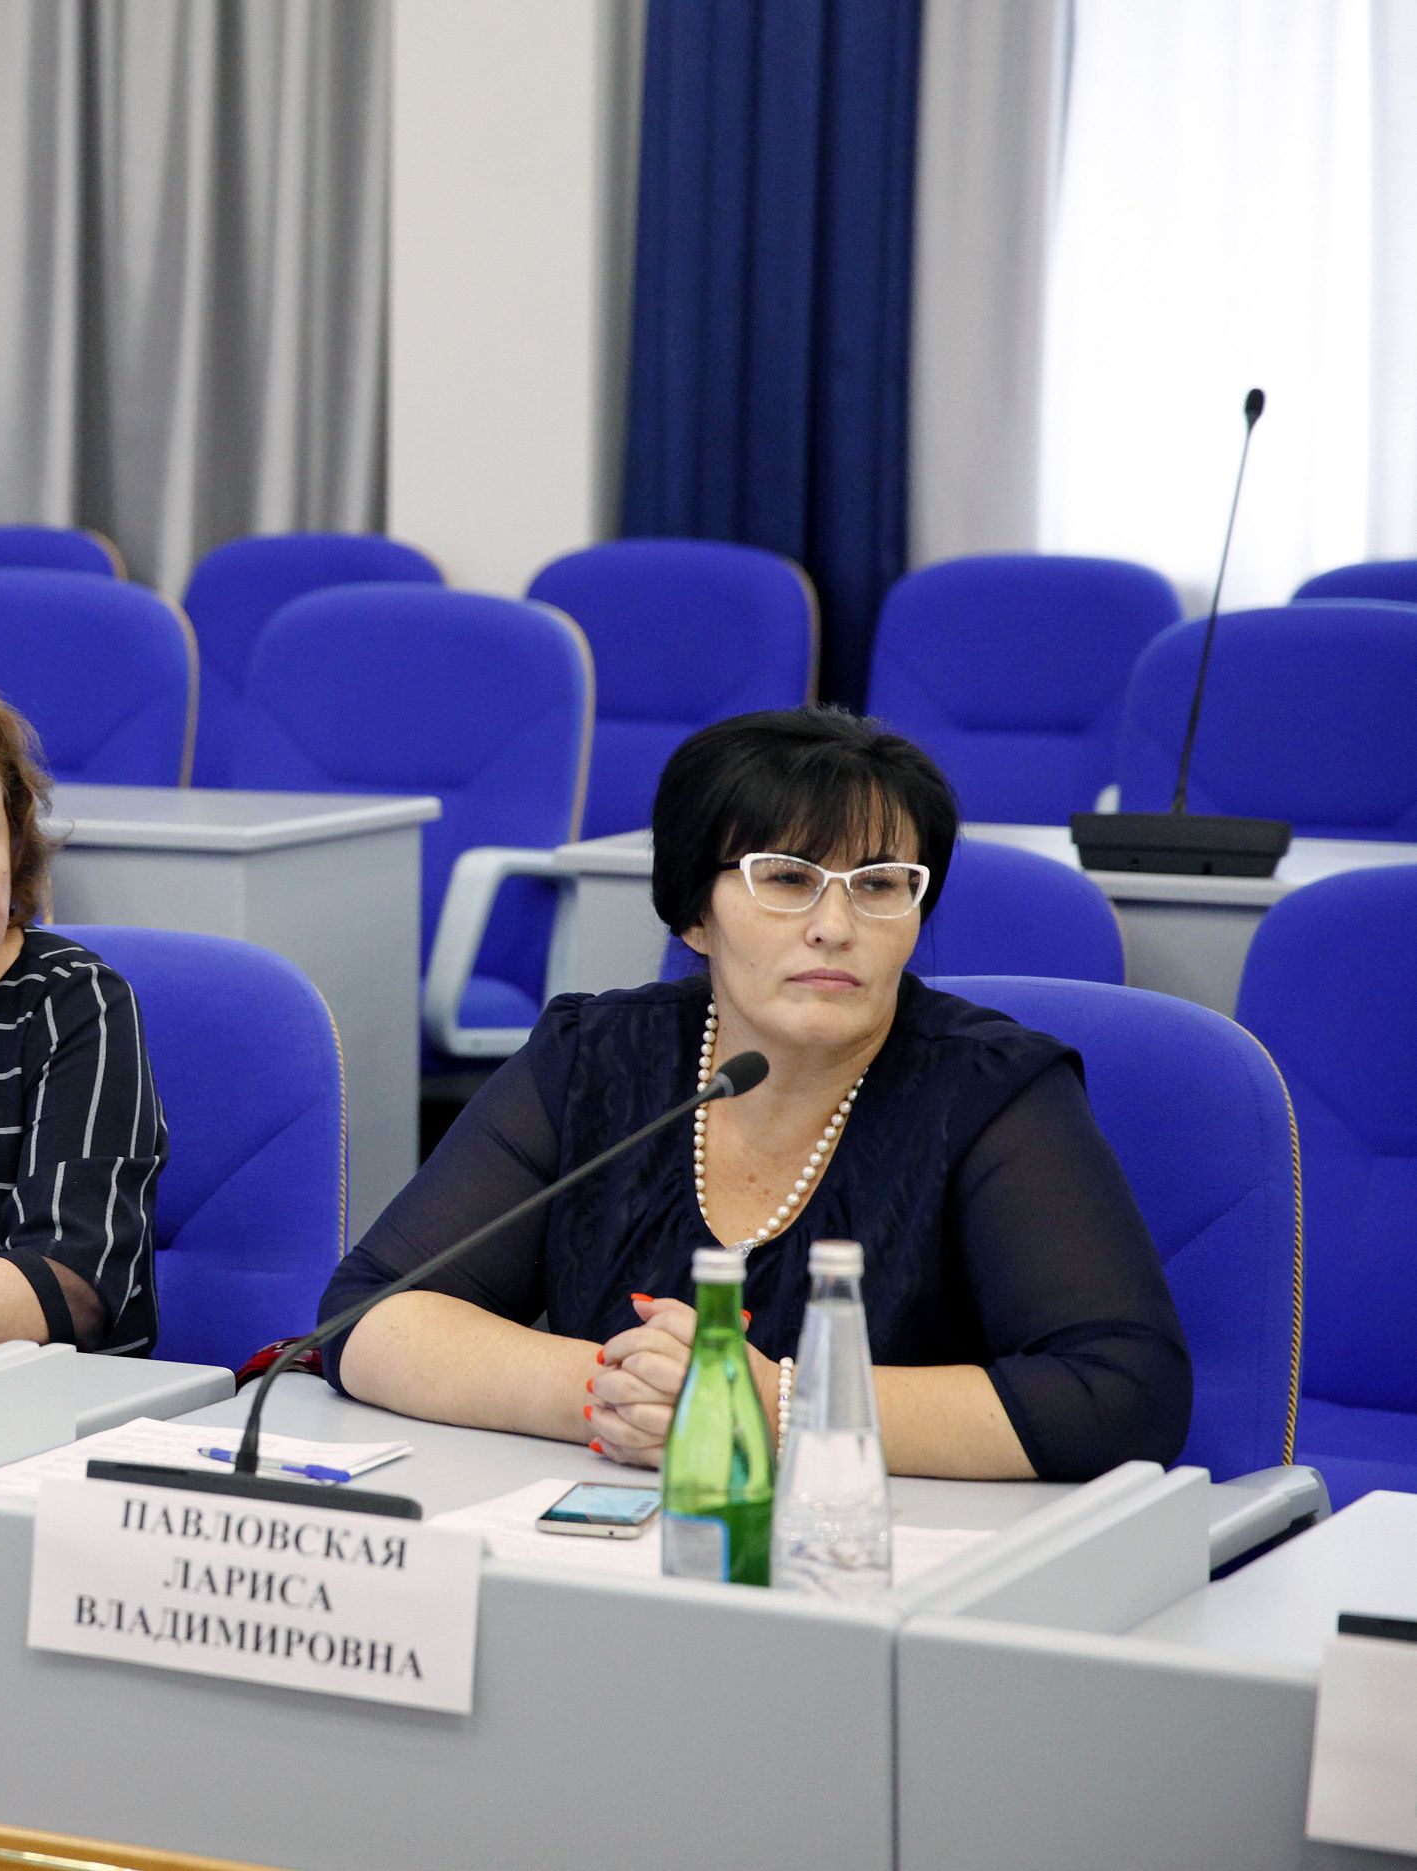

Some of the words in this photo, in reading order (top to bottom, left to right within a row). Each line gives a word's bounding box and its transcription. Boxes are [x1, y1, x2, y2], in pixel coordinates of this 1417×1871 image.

[121, 1498, 407, 1570] ПАВЛОВСКАЯ
[164, 1557, 333, 1612] ЛАРИСА
[75, 1594, 424, 1680] ВЛАДИМИРОВНА
